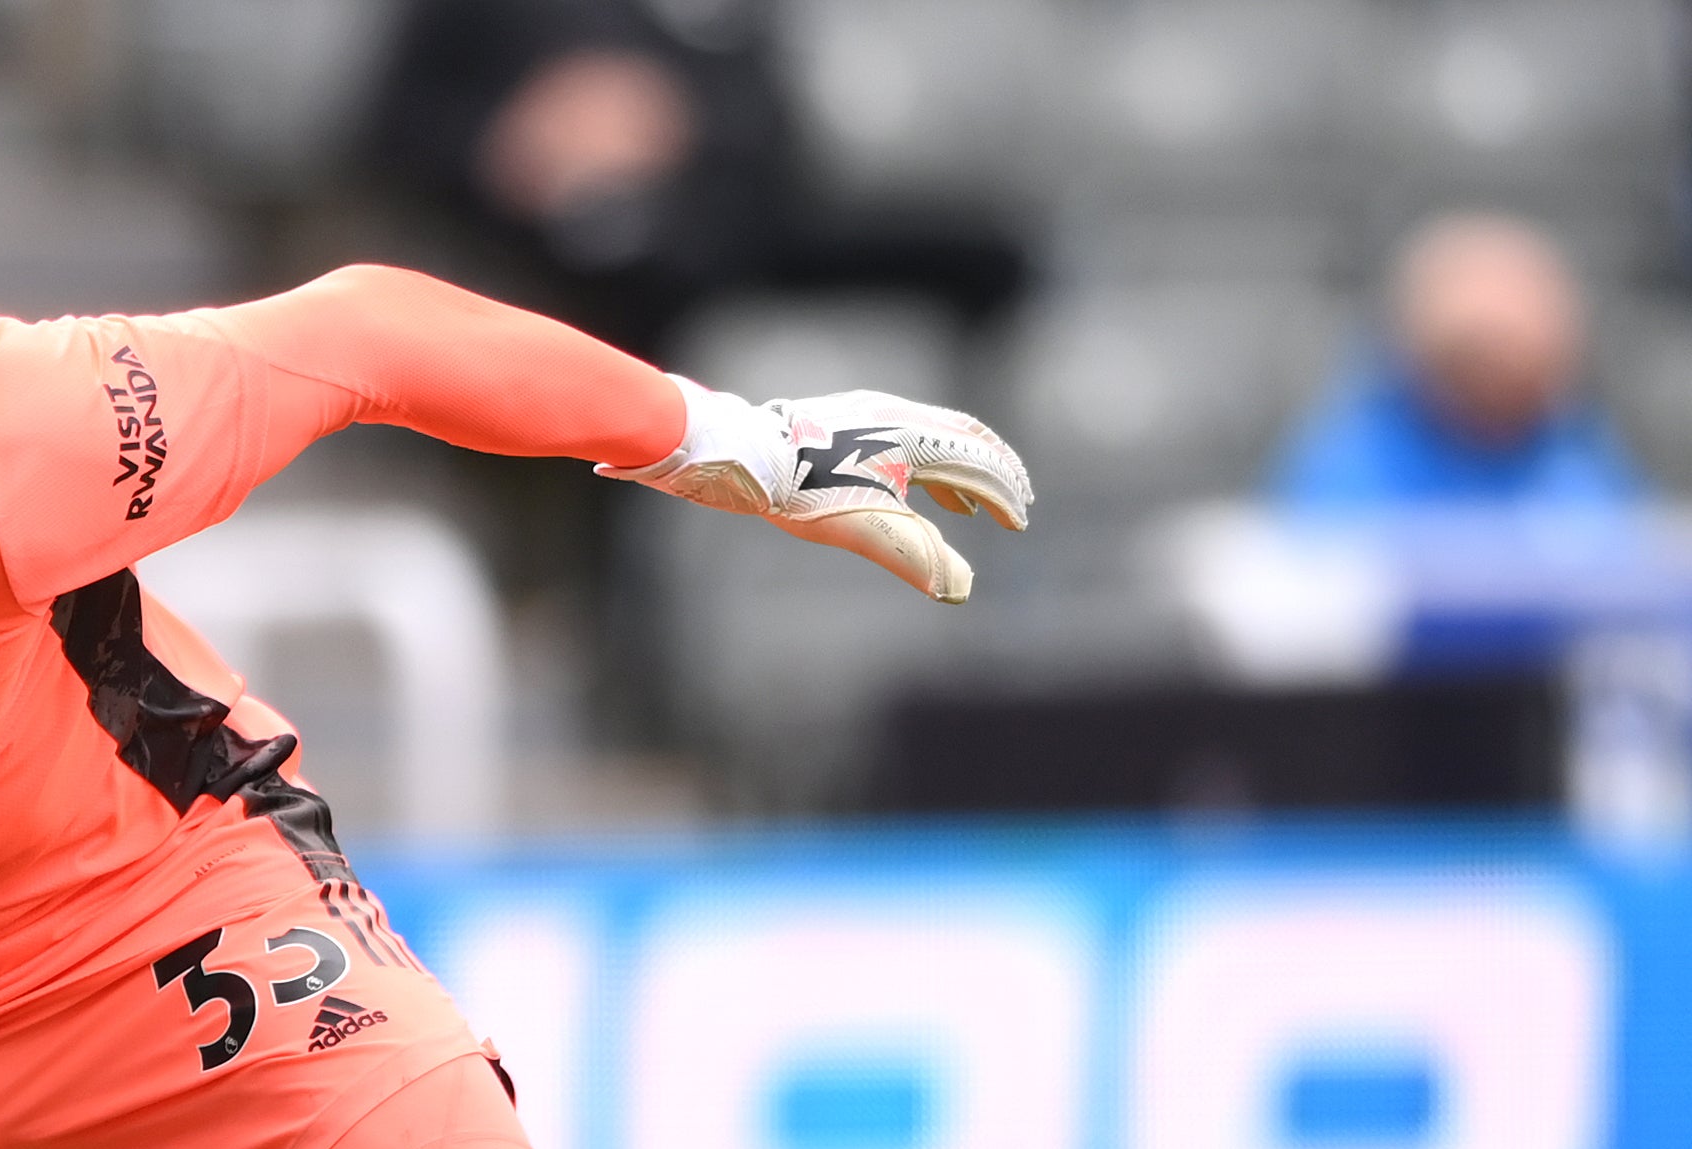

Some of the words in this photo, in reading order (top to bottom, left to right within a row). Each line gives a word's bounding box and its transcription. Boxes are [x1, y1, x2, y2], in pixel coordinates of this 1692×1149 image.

[103, 383, 142, 487] VISIT
[111, 345, 168, 521] RWANDA
[308, 1010, 388, 1052] adidas
